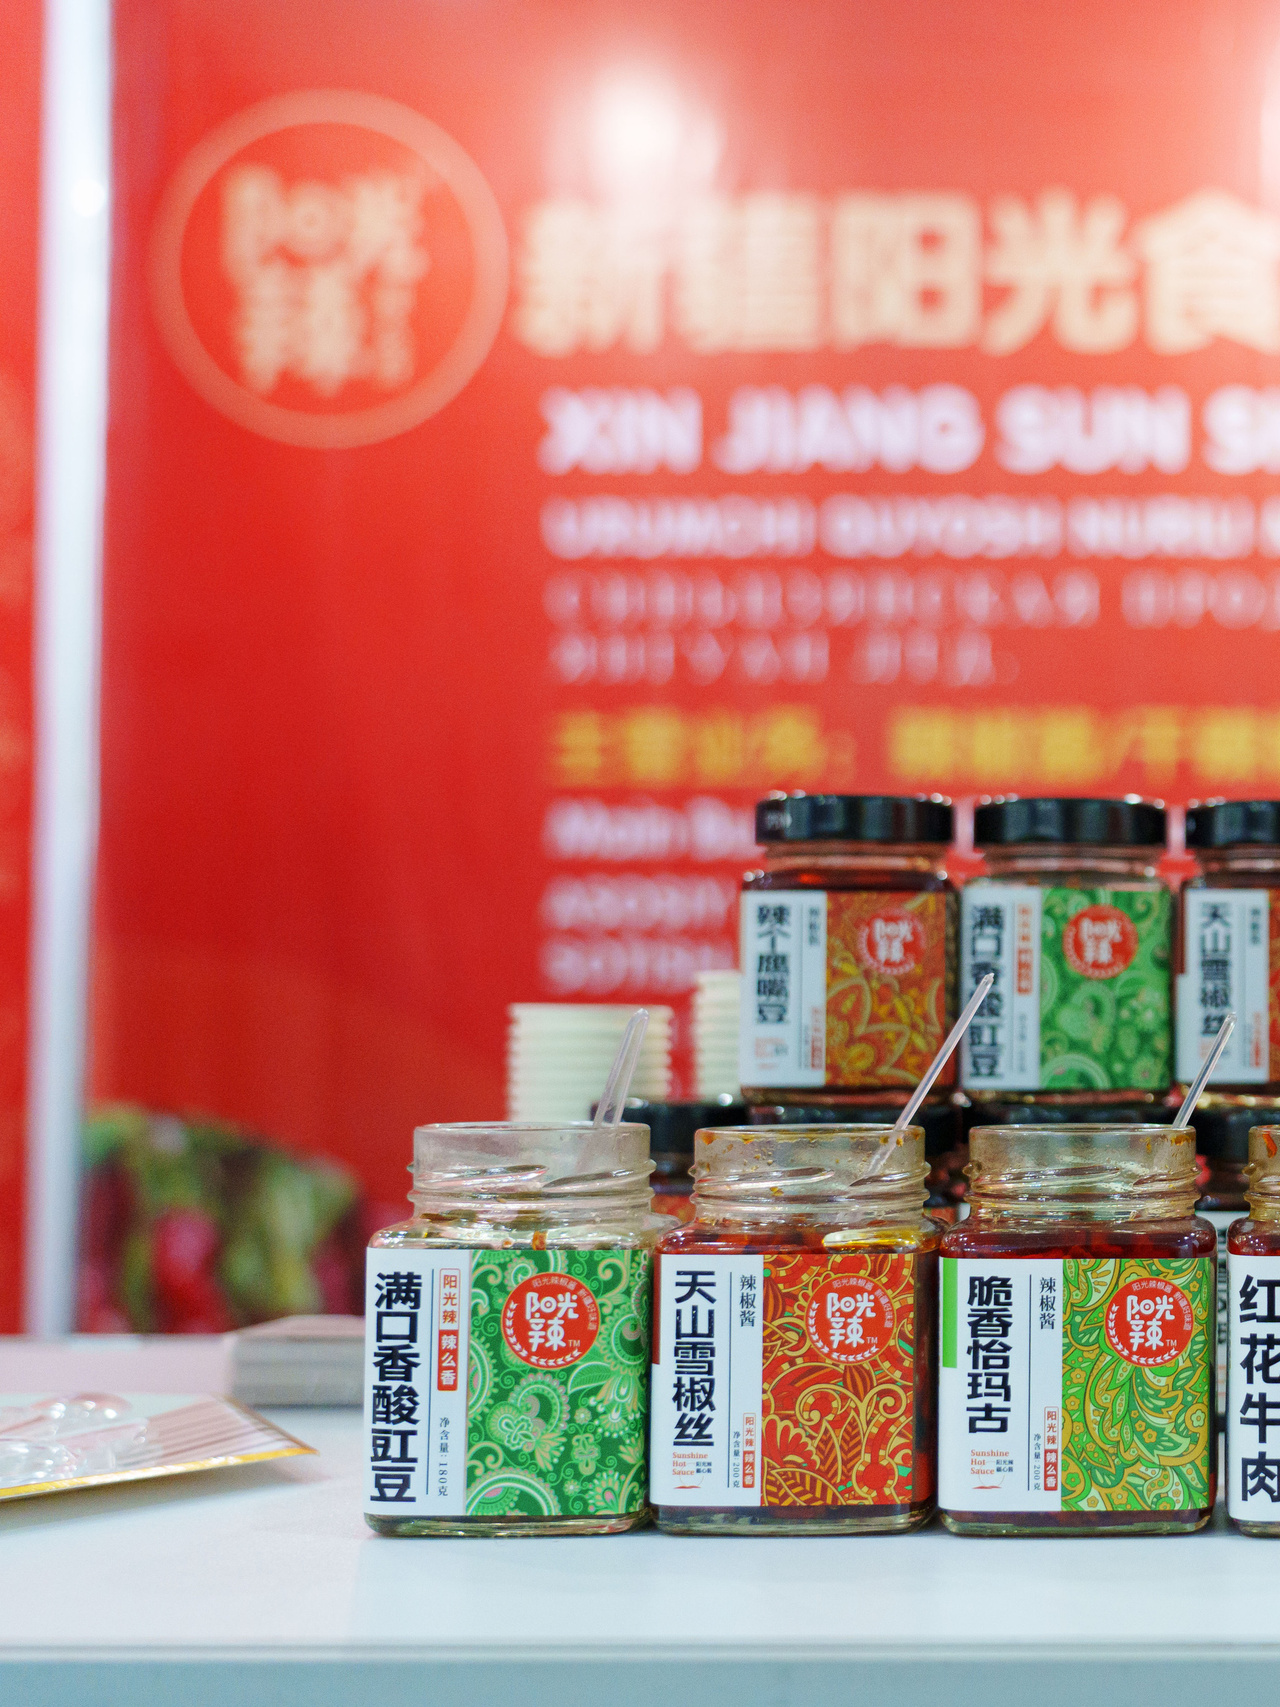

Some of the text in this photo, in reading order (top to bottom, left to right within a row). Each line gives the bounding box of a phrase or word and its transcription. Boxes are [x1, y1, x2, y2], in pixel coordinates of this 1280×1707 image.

[540, 388, 703, 475] XIN
[714, 386, 985, 475] JIANG
[996, 385, 1192, 475] SUN
[756, 904, 791, 1024] 辣个鹰嘴豆
[526, 1292, 579, 1319] 阳光
[739, 1274, 756, 1327] 辣椒酱
[827, 1293, 875, 1317] 阳光
[1039, 1277, 1056, 1330] 辣椒酱
[1127, 1295, 1175, 1321] 阳光
[440, 1274, 457, 1386] 阳光辣 辣么香
[529, 1315, 566, 1351] 辣
[829, 1316, 864, 1348] 辣
[1130, 1319, 1163, 1351] 辣
[672, 1270, 717, 1446] 天山雪椒丝
[966, 1275, 1012, 1433] 脆香恰玛古
[370, 1272, 422, 1502] 满口香酸豇豆
[971, 1449, 1009, 1457] Sunshine
[971, 1467, 994, 1475] Sauce
[1046, 1411, 1057, 1487] 阳光辣 辣么香
[672, 1468, 695, 1476] Sauce
